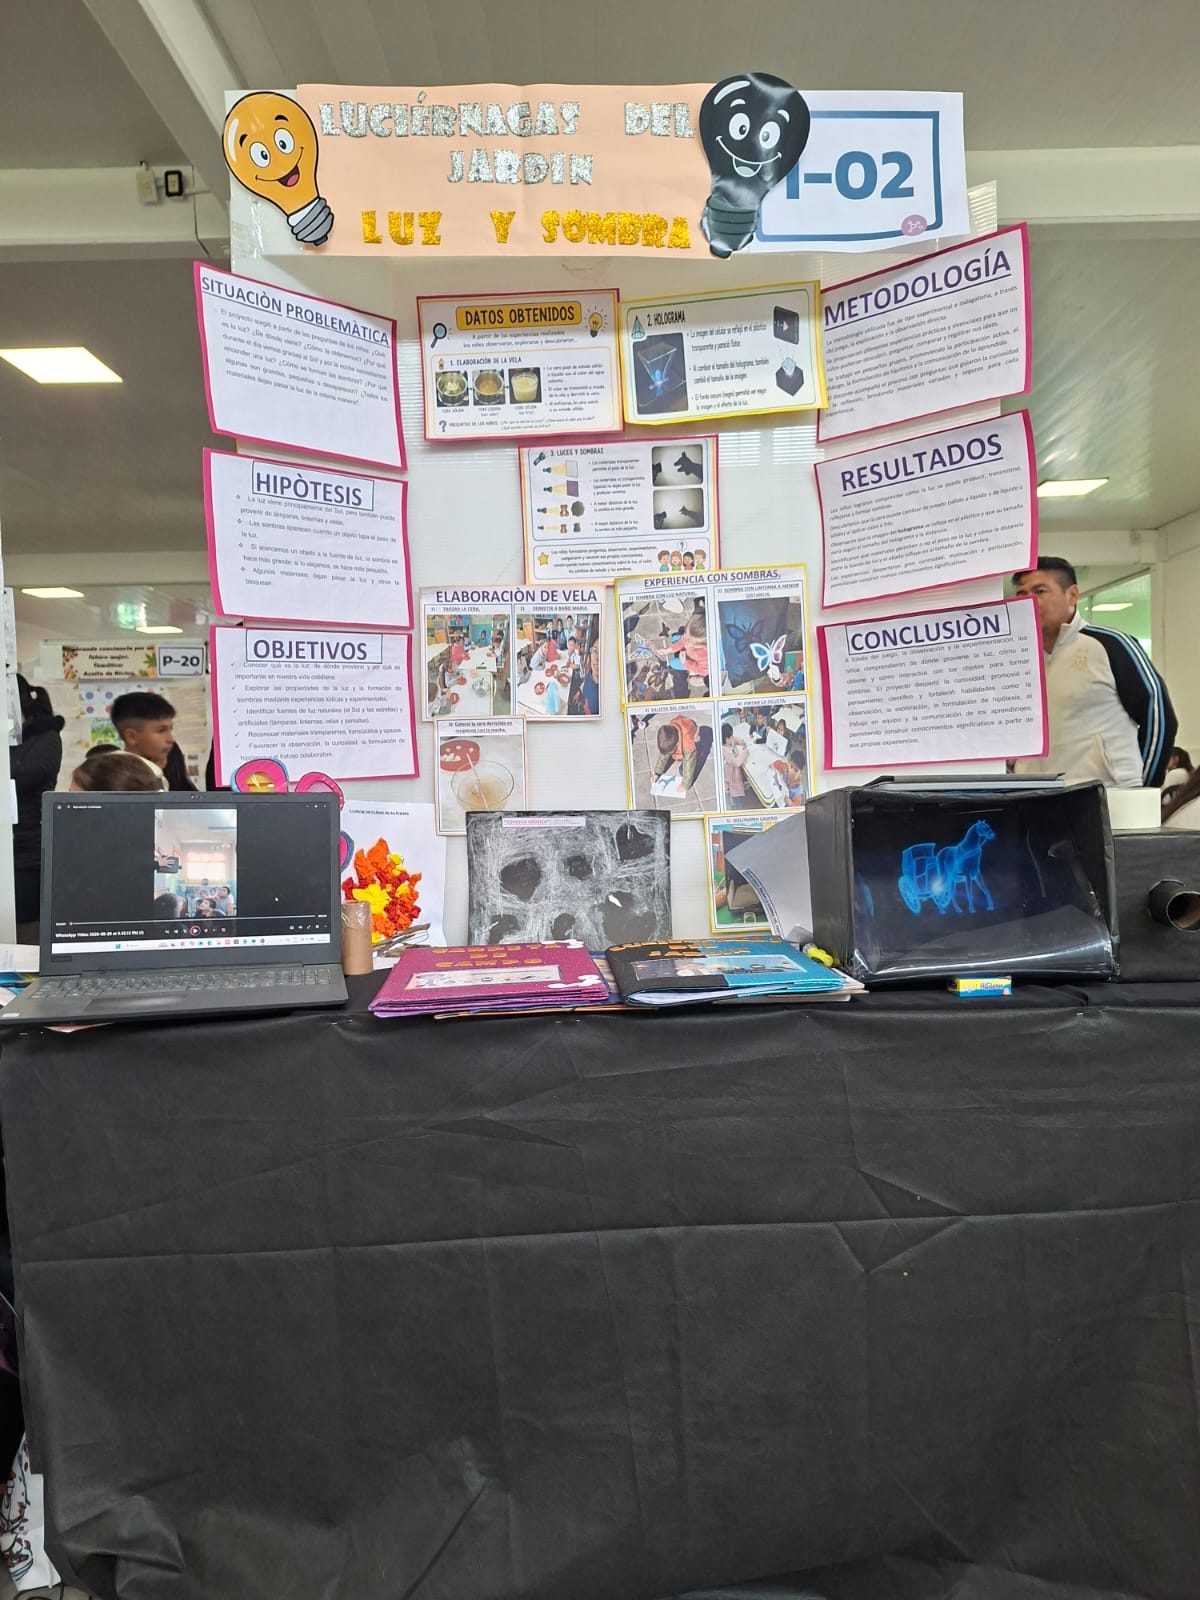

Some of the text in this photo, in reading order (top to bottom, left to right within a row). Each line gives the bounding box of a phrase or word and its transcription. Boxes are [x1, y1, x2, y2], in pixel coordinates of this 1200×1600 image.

[319, 90, 695, 138] LUCIÉRNAGAS DEL
[448, 148, 593, 186] JARDIN
[361, 209, 692, 248] LUZ Y SOMBRA
[824, 248, 1011, 327] METODOLOGÍA
[202, 276, 390, 346] SITUACIÒN PROBLEMÀTICA
[465, 306, 575, 326] DATOS OBTENIDOS
[647, 310, 686, 326] 2. HOLOGRAMA
[580, 448, 604, 456] SOMBRAS
[840, 433, 1003, 492] RESULTADOS
[256, 472, 362, 508] HIPÒTESIS
[436, 587, 598, 604] ELABORACIÒN DE VELA
[644, 576, 705, 588] EXPERIENCIA
[707, 573, 729, 584] CON
[730, 569, 782, 582] SOMBRAS.
[253, 639, 368, 661] OBJETIVOS
[850, 614, 1001, 652] CONCLUSIÒN
[163, 656, 200, 667] P-20
